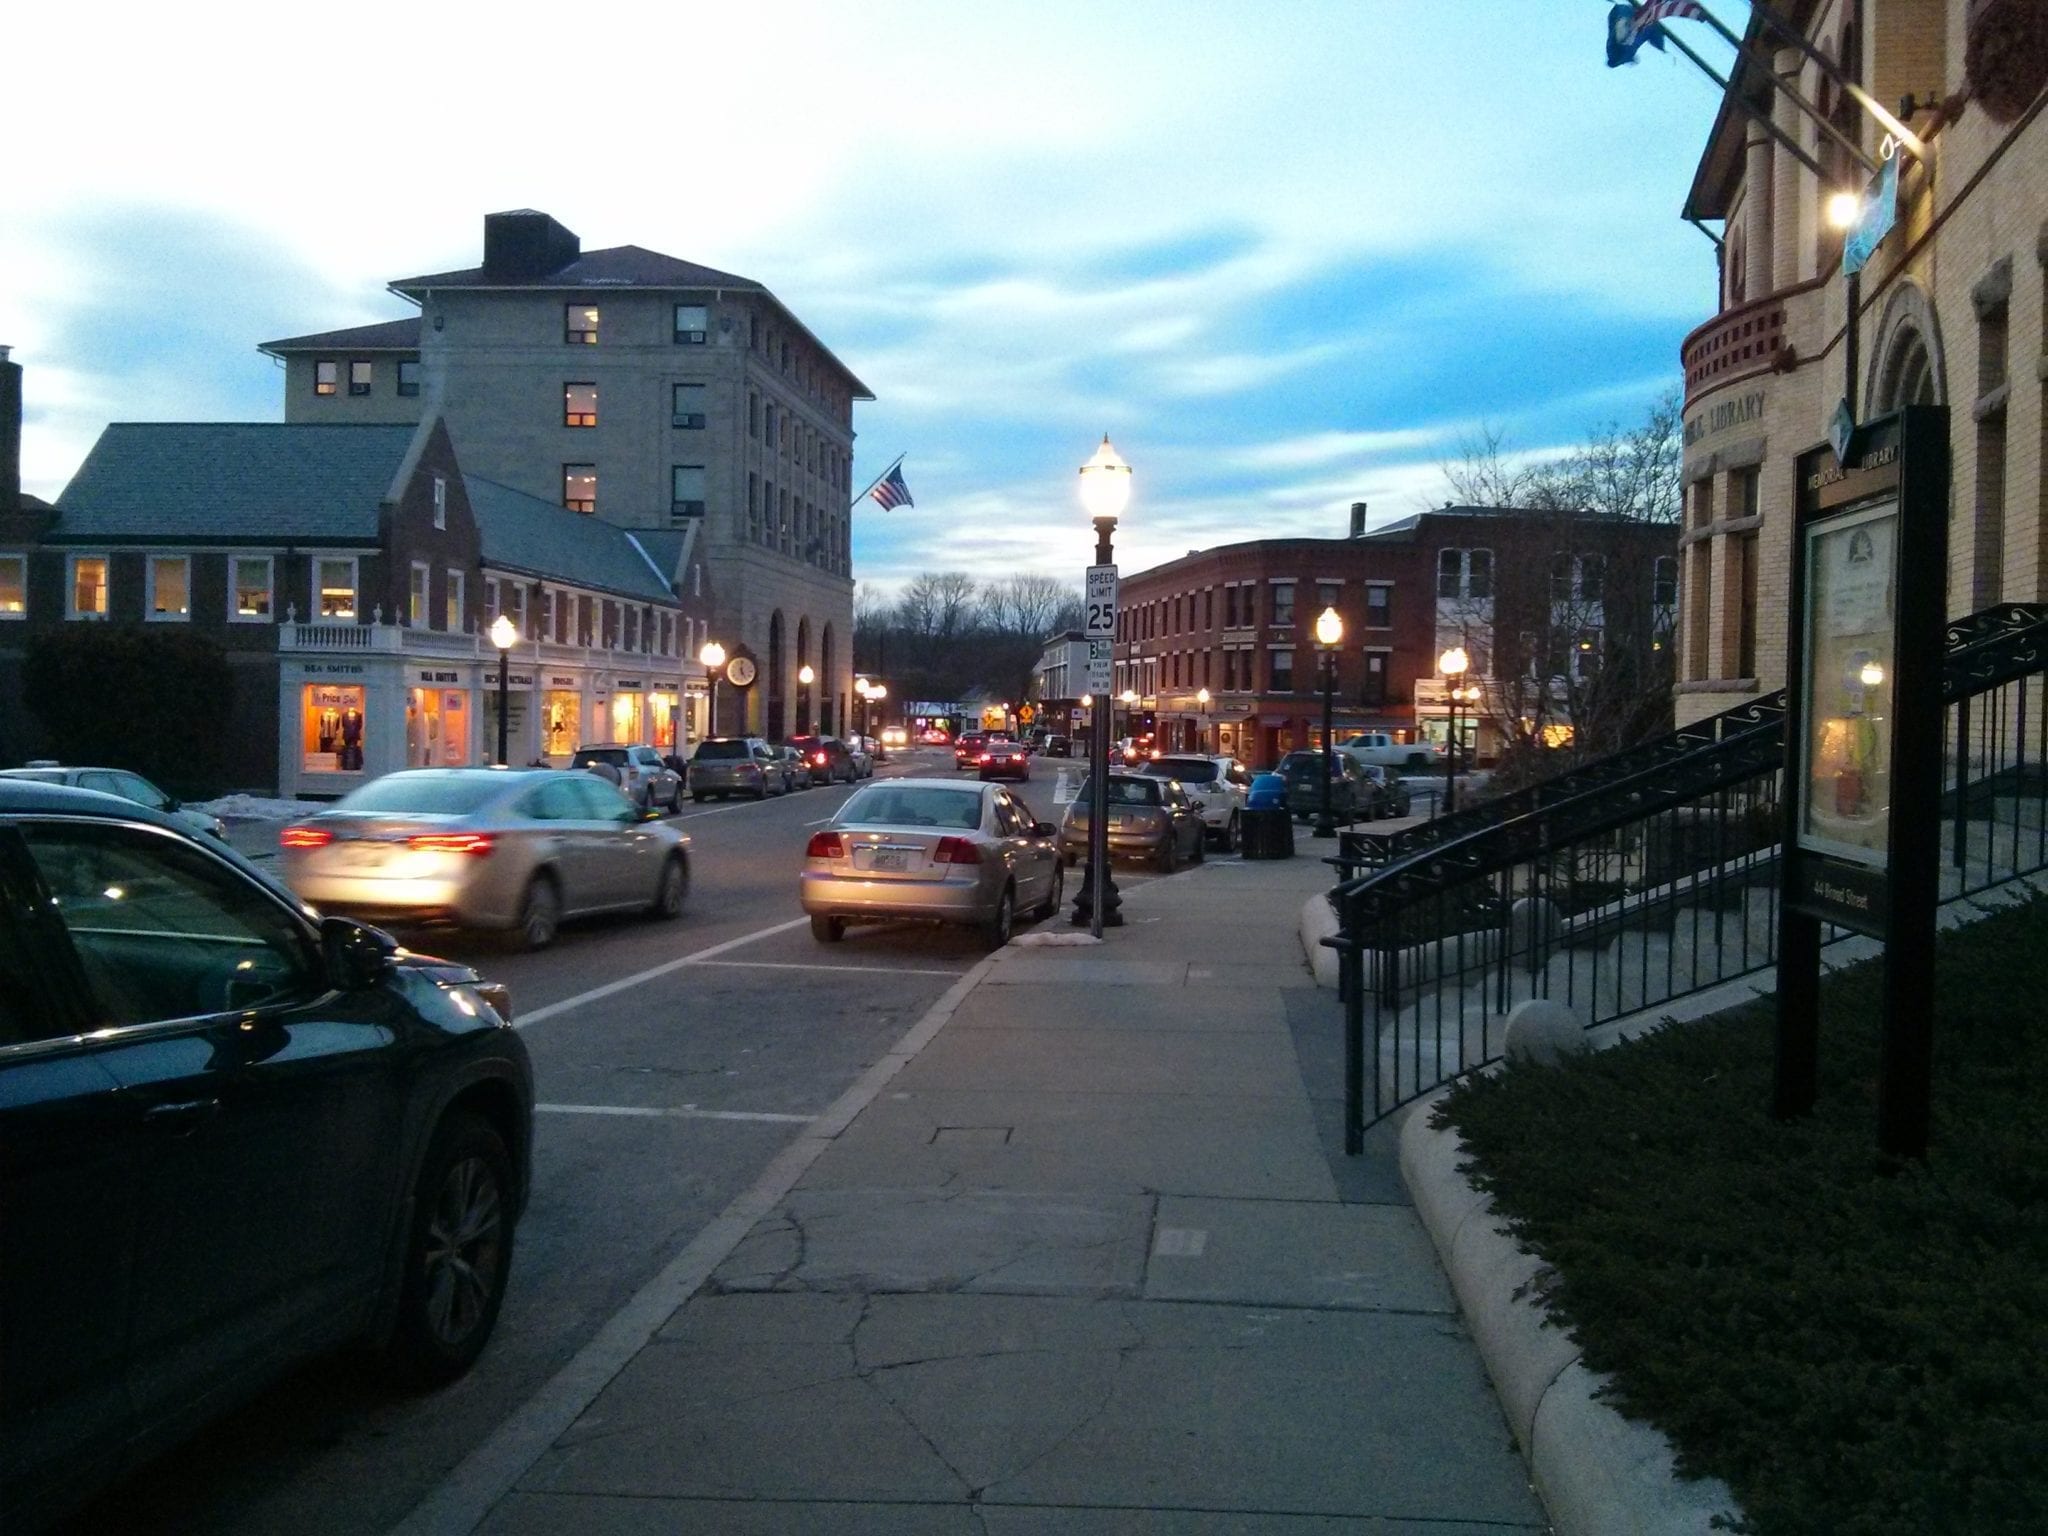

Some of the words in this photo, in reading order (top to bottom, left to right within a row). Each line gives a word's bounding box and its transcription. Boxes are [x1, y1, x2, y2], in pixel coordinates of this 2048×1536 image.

[1710, 389, 1765, 434] LIBRARY
[1862, 446, 1898, 472] LIBRARY
[1089, 573, 1115, 584] SPEED
[1091, 587, 1113, 598] LIMIT
[1088, 604, 1114, 630] 25
